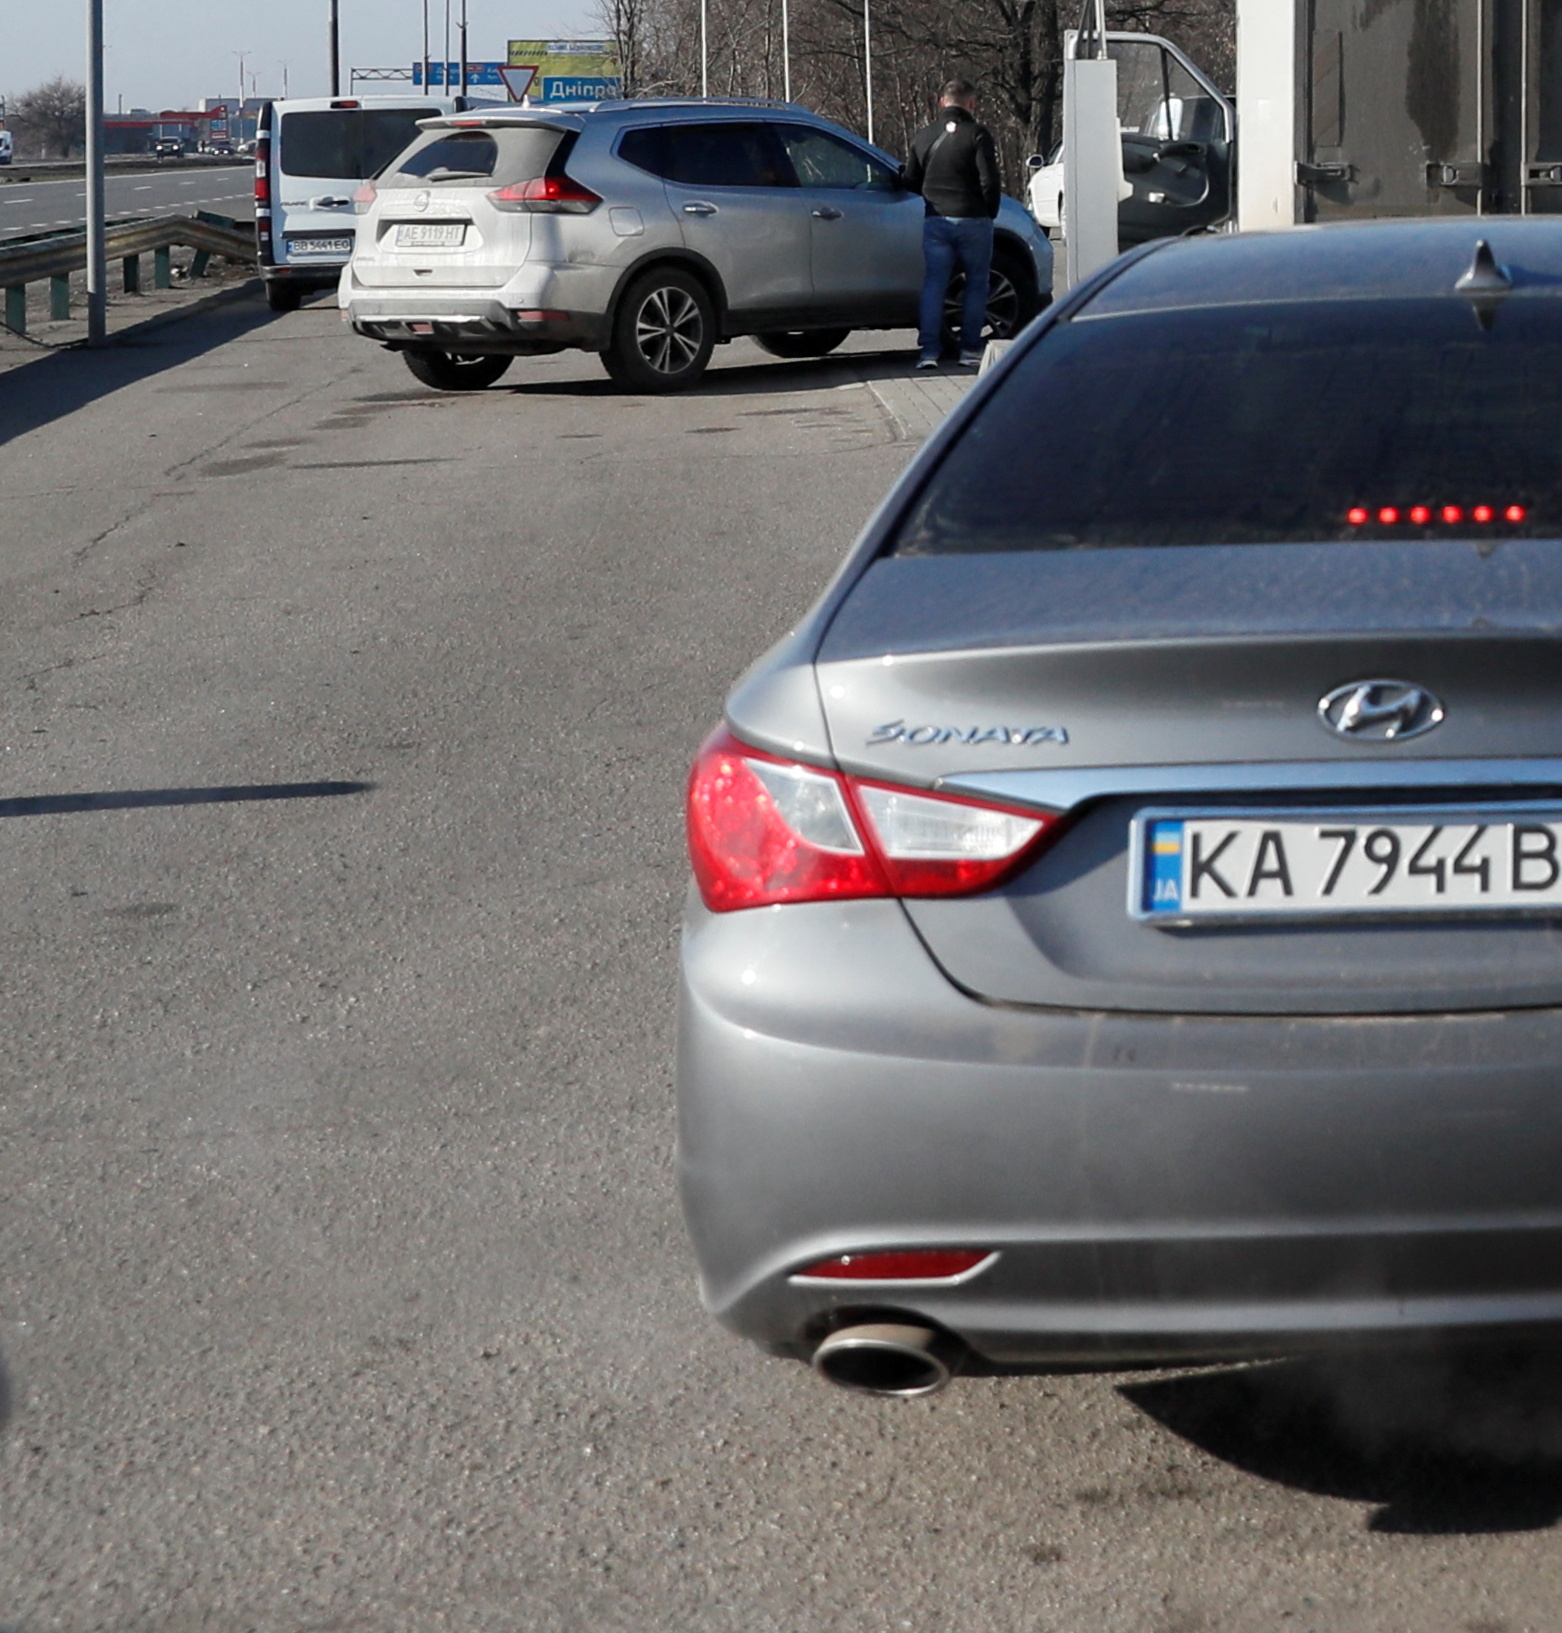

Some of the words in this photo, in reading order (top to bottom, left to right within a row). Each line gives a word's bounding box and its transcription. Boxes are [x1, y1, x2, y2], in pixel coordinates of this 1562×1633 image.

[549, 80, 617, 99] Дніпро
[403, 226, 419, 240] AE
[420, 226, 445, 240] 9119
[445, 226, 462, 240] HT
[865, 719, 1069, 746] SONATA
[1189, 829, 1294, 900] KA
[1317, 825, 1491, 897] 7944
